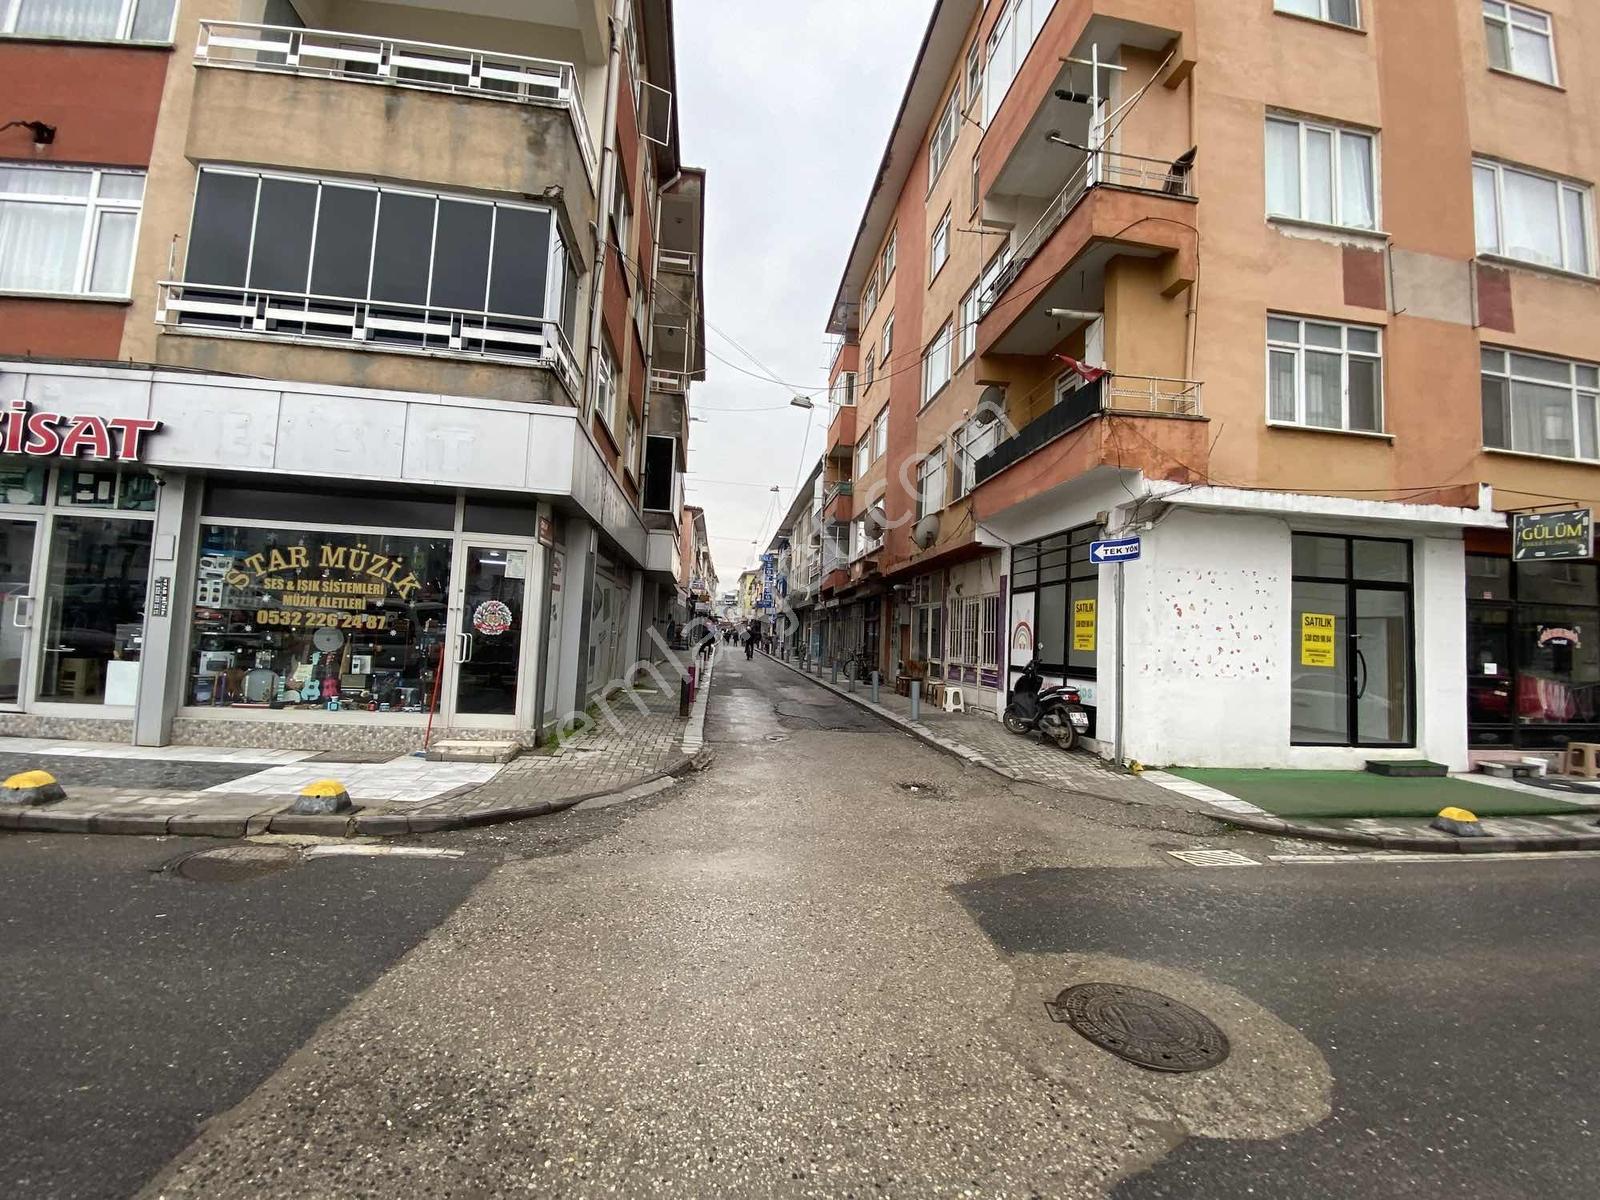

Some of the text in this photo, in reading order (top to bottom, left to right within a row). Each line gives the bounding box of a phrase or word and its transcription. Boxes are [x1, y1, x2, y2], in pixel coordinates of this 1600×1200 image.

[0, 400, 157, 461] İSAT
[1522, 522, 1583, 541] GÜLÜM
[1104, 544, 1138, 555] TEK YÖN
[225, 544, 421, 599] STAR MÜZİK
[264, 578, 385, 595] SES & IŞIK SİSTEMLERİ
[283, 594, 366, 610] MÜZİK ALETLERİ
[257, 610, 386, 630] 0532 226 24 87
[1304, 616, 1332, 628] SATILIK
